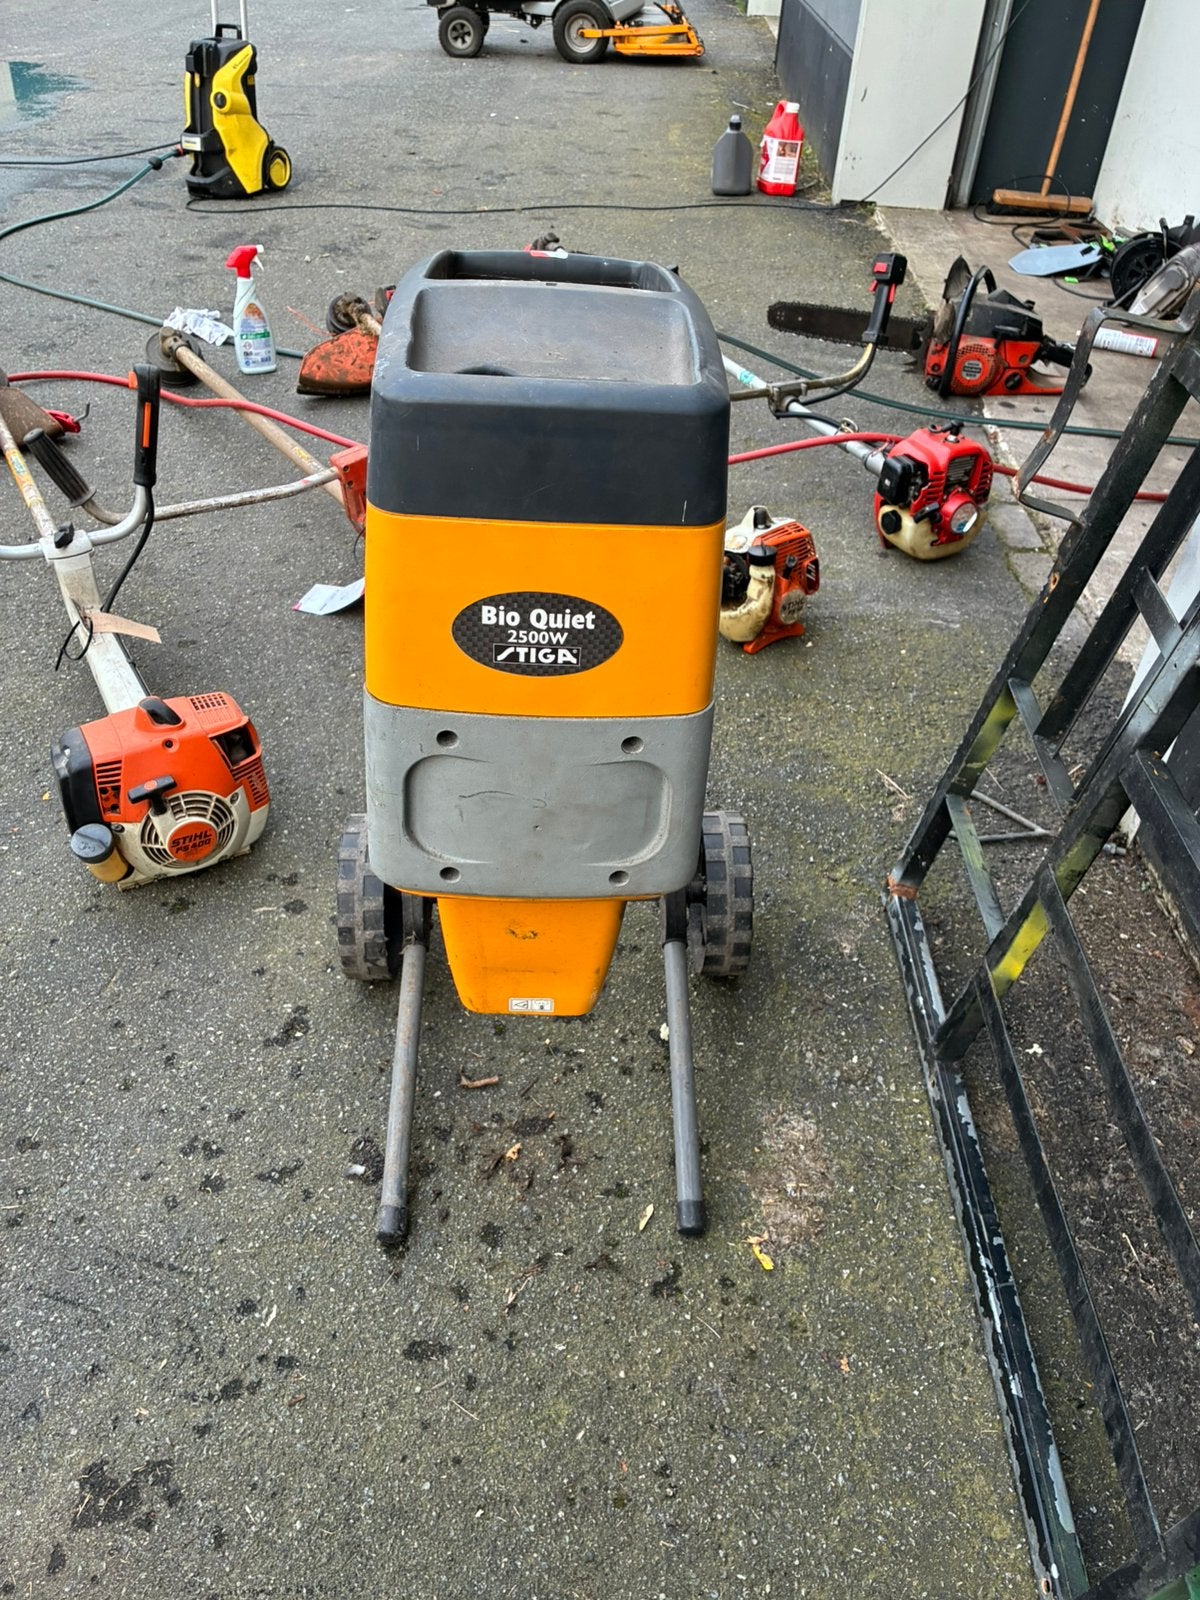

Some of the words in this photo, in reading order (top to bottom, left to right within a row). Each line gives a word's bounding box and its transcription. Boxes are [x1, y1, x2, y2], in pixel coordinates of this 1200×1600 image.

[481, 605, 521, 626] Bio
[529, 608, 596, 630] Quiet
[507, 629, 569, 645] 2500W
[496, 646, 578, 664] STIGA
[171, 829, 212, 848] STIHL
[191, 838, 212, 850] 400
